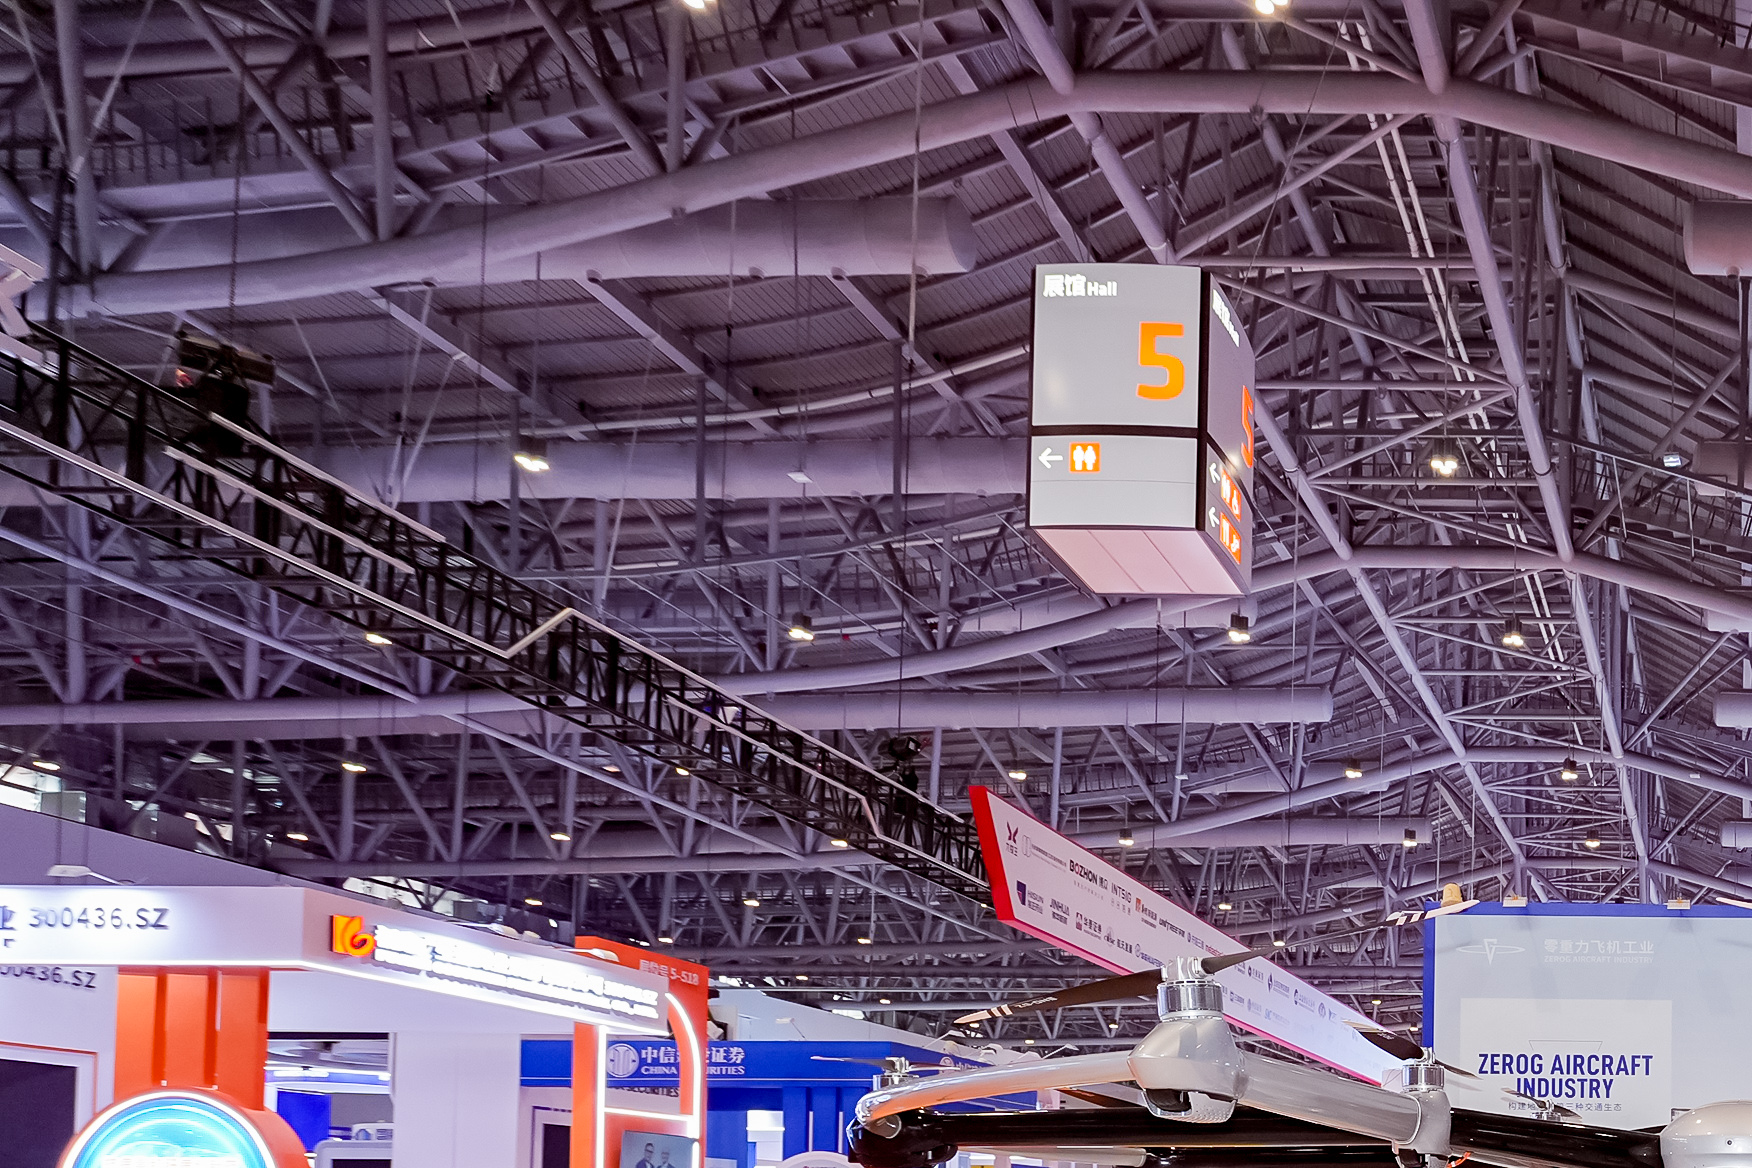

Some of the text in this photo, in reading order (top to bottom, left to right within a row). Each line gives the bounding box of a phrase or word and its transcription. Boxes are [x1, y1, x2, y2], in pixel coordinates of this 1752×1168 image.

[1043, 274, 1117, 297] 展馆 Hall
[1136, 321, 1185, 400] 5
[1241, 385, 1254, 469] 5
[1069, 859, 1098, 886] BOZHON
[29, 906, 169, 929] 300436.SZ
[1544, 938, 1654, 954] 零重力飞机工业
[1544, 955, 1654, 964] ZEROG AIRCRAFT INDUSTRY
[670, 968, 699, 986] 5-518
[641, 1046, 745, 1064] 中信证券
[1478, 1053, 1653, 1076] ZEROG AIRCRAFT
[641, 1066, 677, 1075] CHINA
[1516, 1077, 1614, 1099] INDUSTRY
